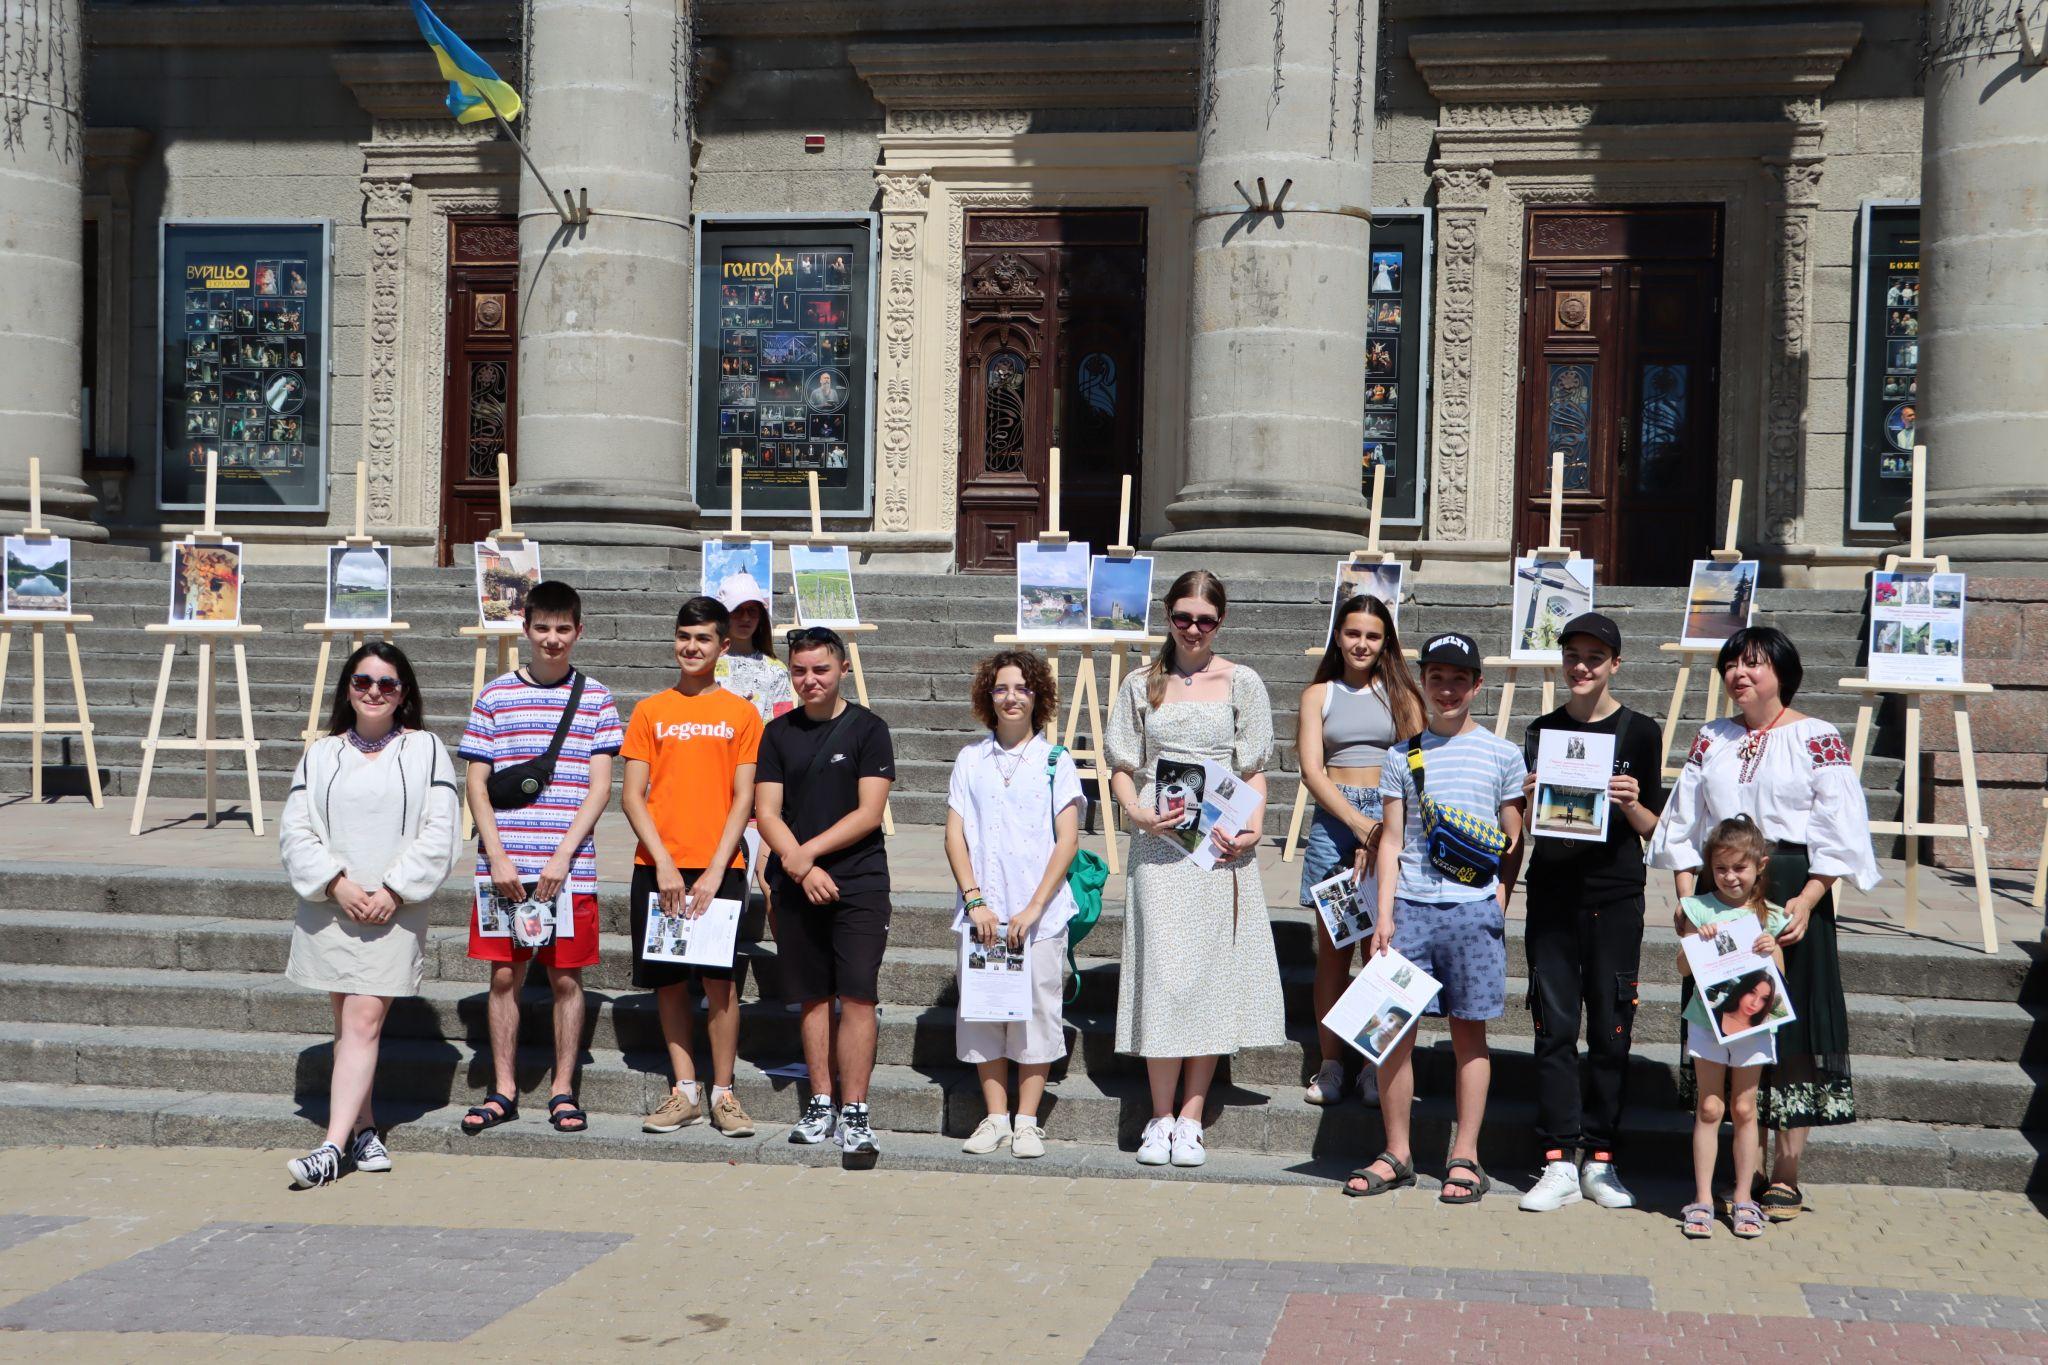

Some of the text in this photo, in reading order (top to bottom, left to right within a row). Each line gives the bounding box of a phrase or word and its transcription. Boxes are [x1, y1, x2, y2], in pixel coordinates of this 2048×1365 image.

[187, 265, 248, 281] ВУЙЦЬО
[724, 253, 794, 289] ГОЛГОФА
[656, 721, 735, 740] Legends
